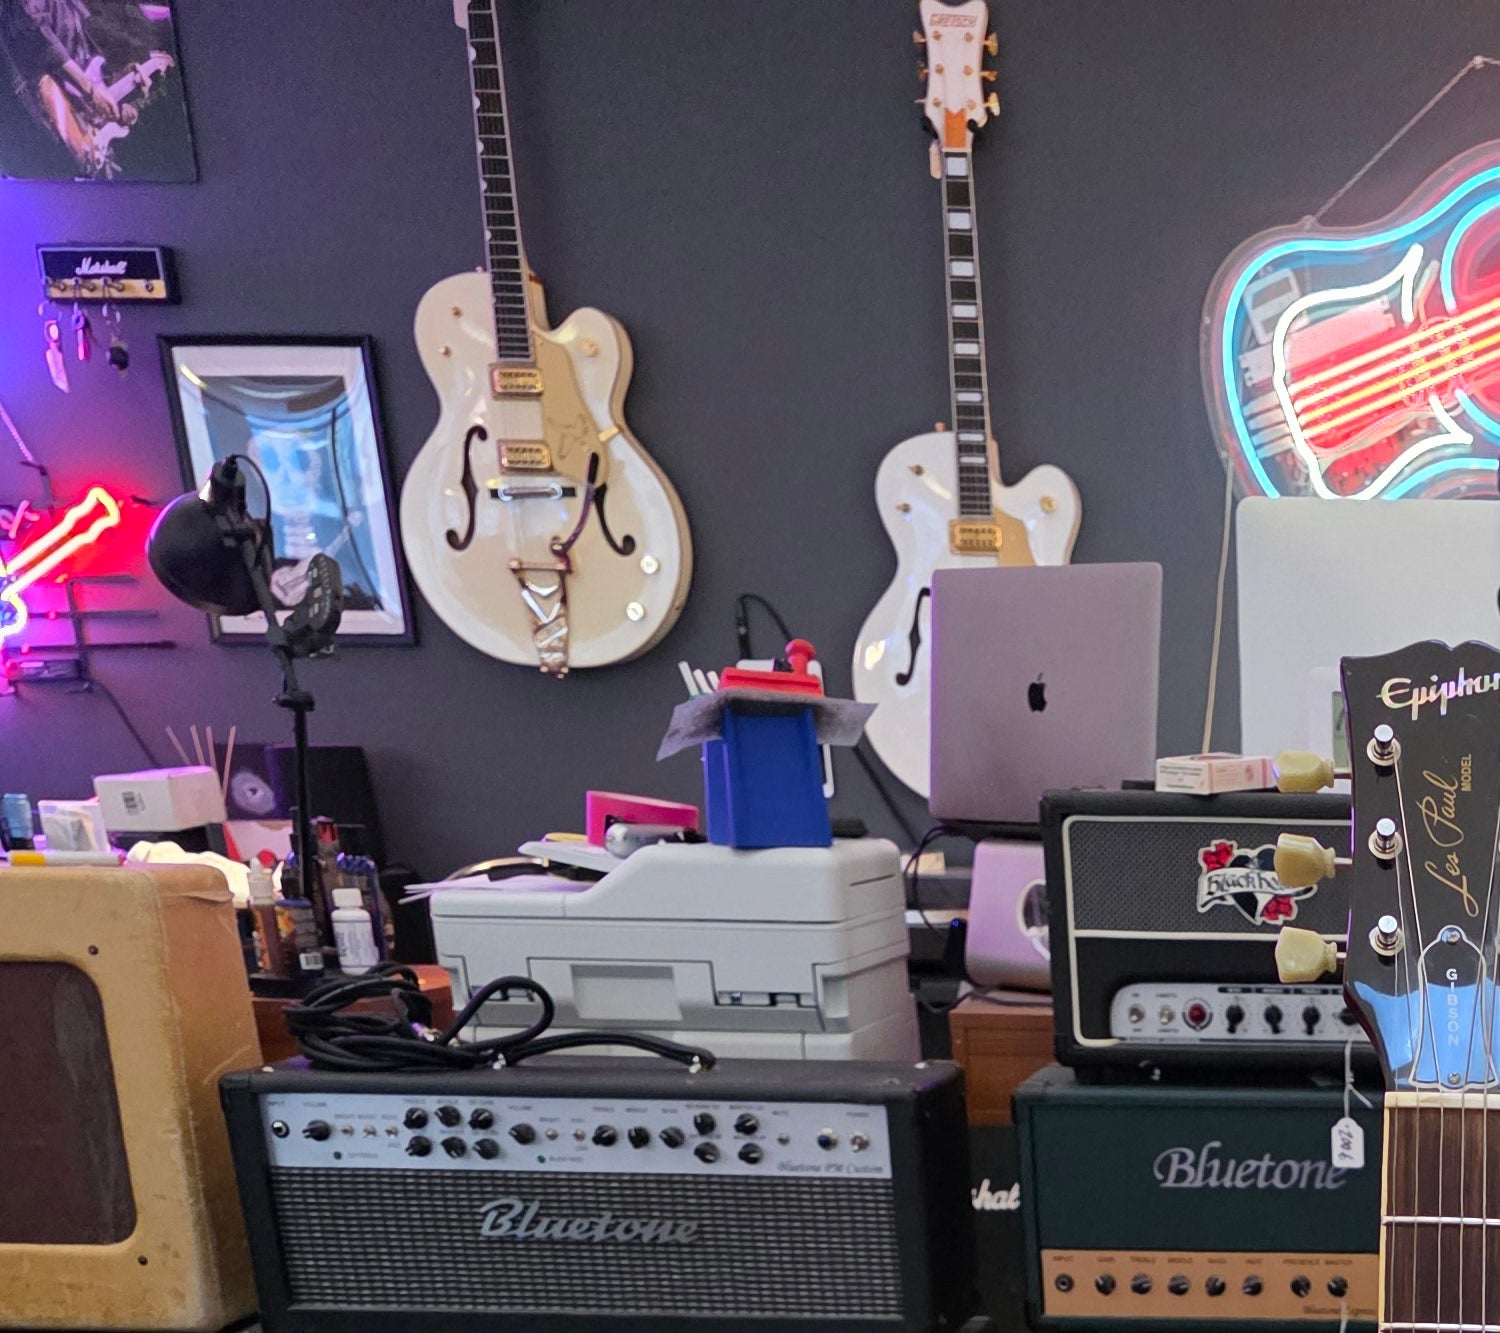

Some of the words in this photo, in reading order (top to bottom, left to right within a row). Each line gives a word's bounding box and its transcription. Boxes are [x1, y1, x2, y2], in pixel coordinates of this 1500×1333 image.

[1461, 754, 1472, 792] MODEL
[1416, 770, 1464, 848] Paul
[1424, 851, 1479, 918] Les
[1446, 968, 1460, 1046] GIBSON
[1153, 1140, 1347, 1190] Bluetone
[480, 1197, 700, 1243] Bluetone
